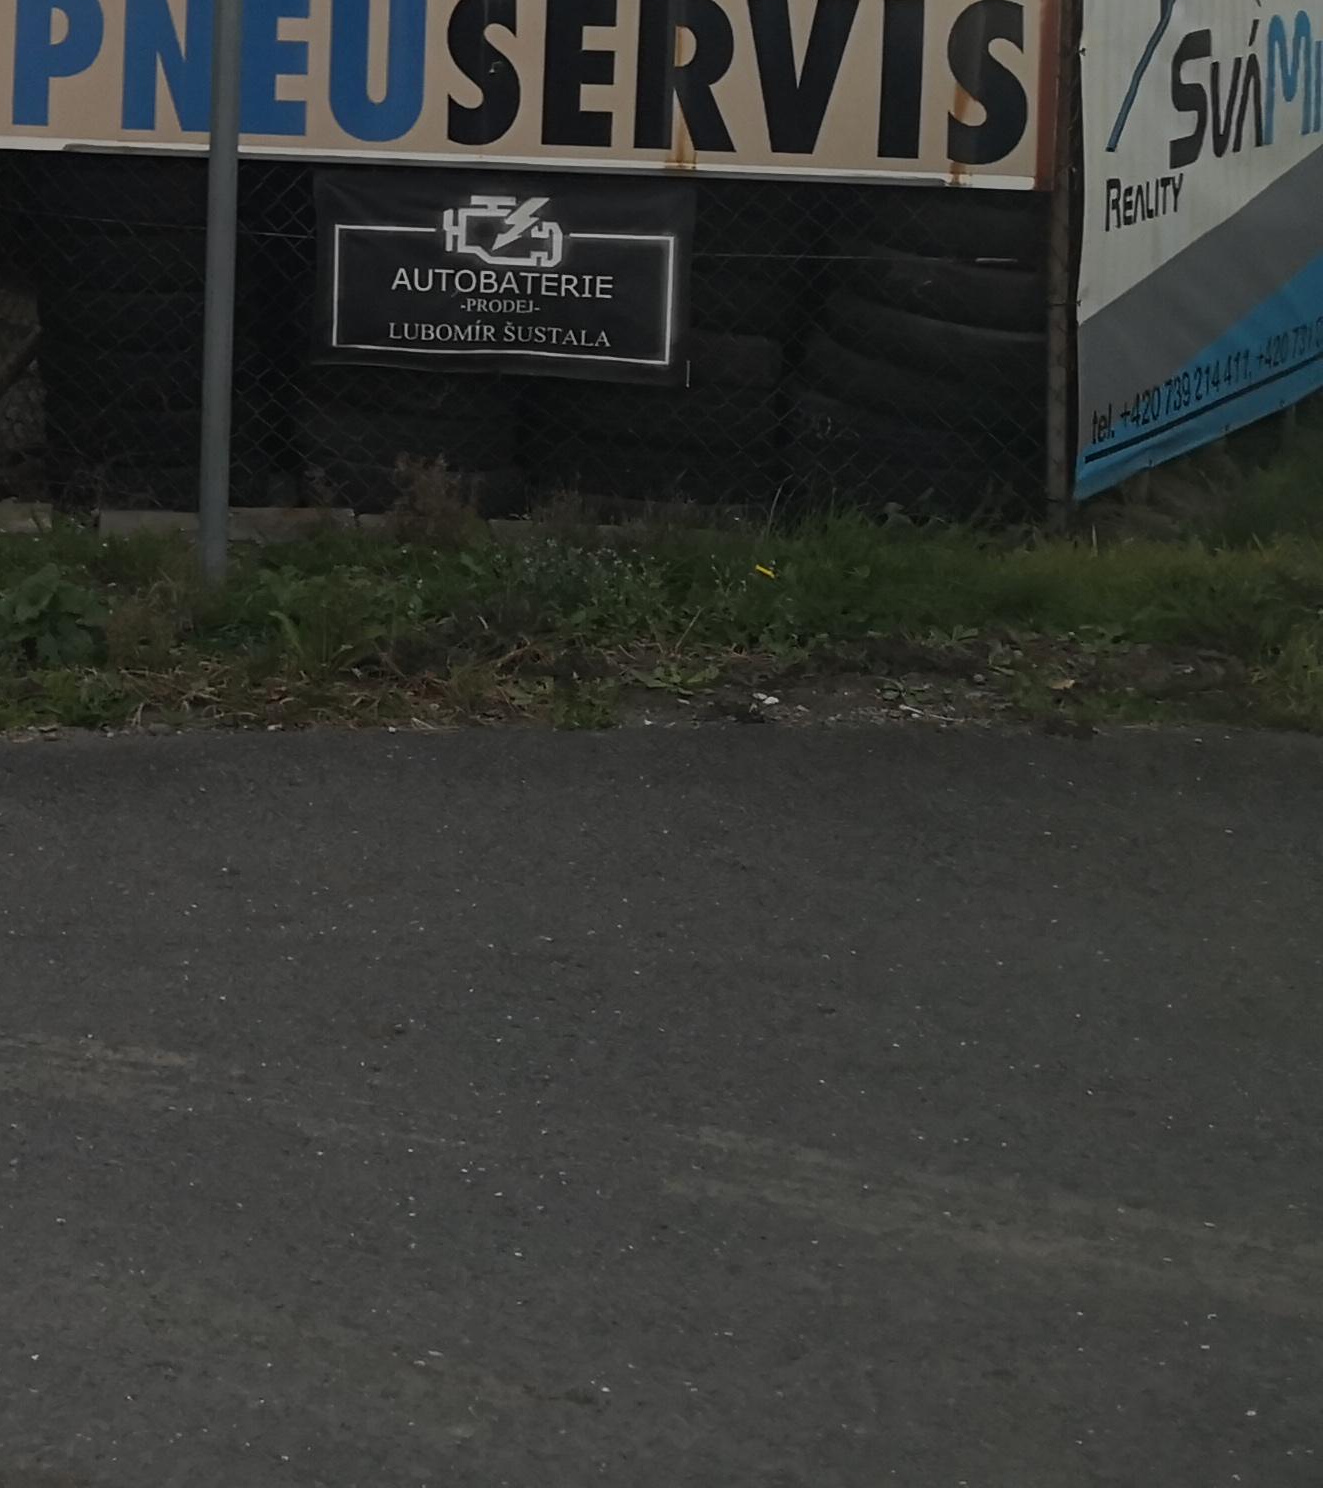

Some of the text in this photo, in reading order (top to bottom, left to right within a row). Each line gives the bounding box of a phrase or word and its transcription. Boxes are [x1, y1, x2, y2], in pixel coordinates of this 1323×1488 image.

[1105, 172, 1185, 232] REALITY
[391, 266, 615, 300] AUTOBATERIE
[388, 319, 612, 348] LUBOMÍR ŠUSTALA
[1091, 402, 1115, 445] tel.
[1120, 385, 1161, 430] +420
[1164, 370, 1191, 416] 739
[1193, 359, 1220, 401] 214
